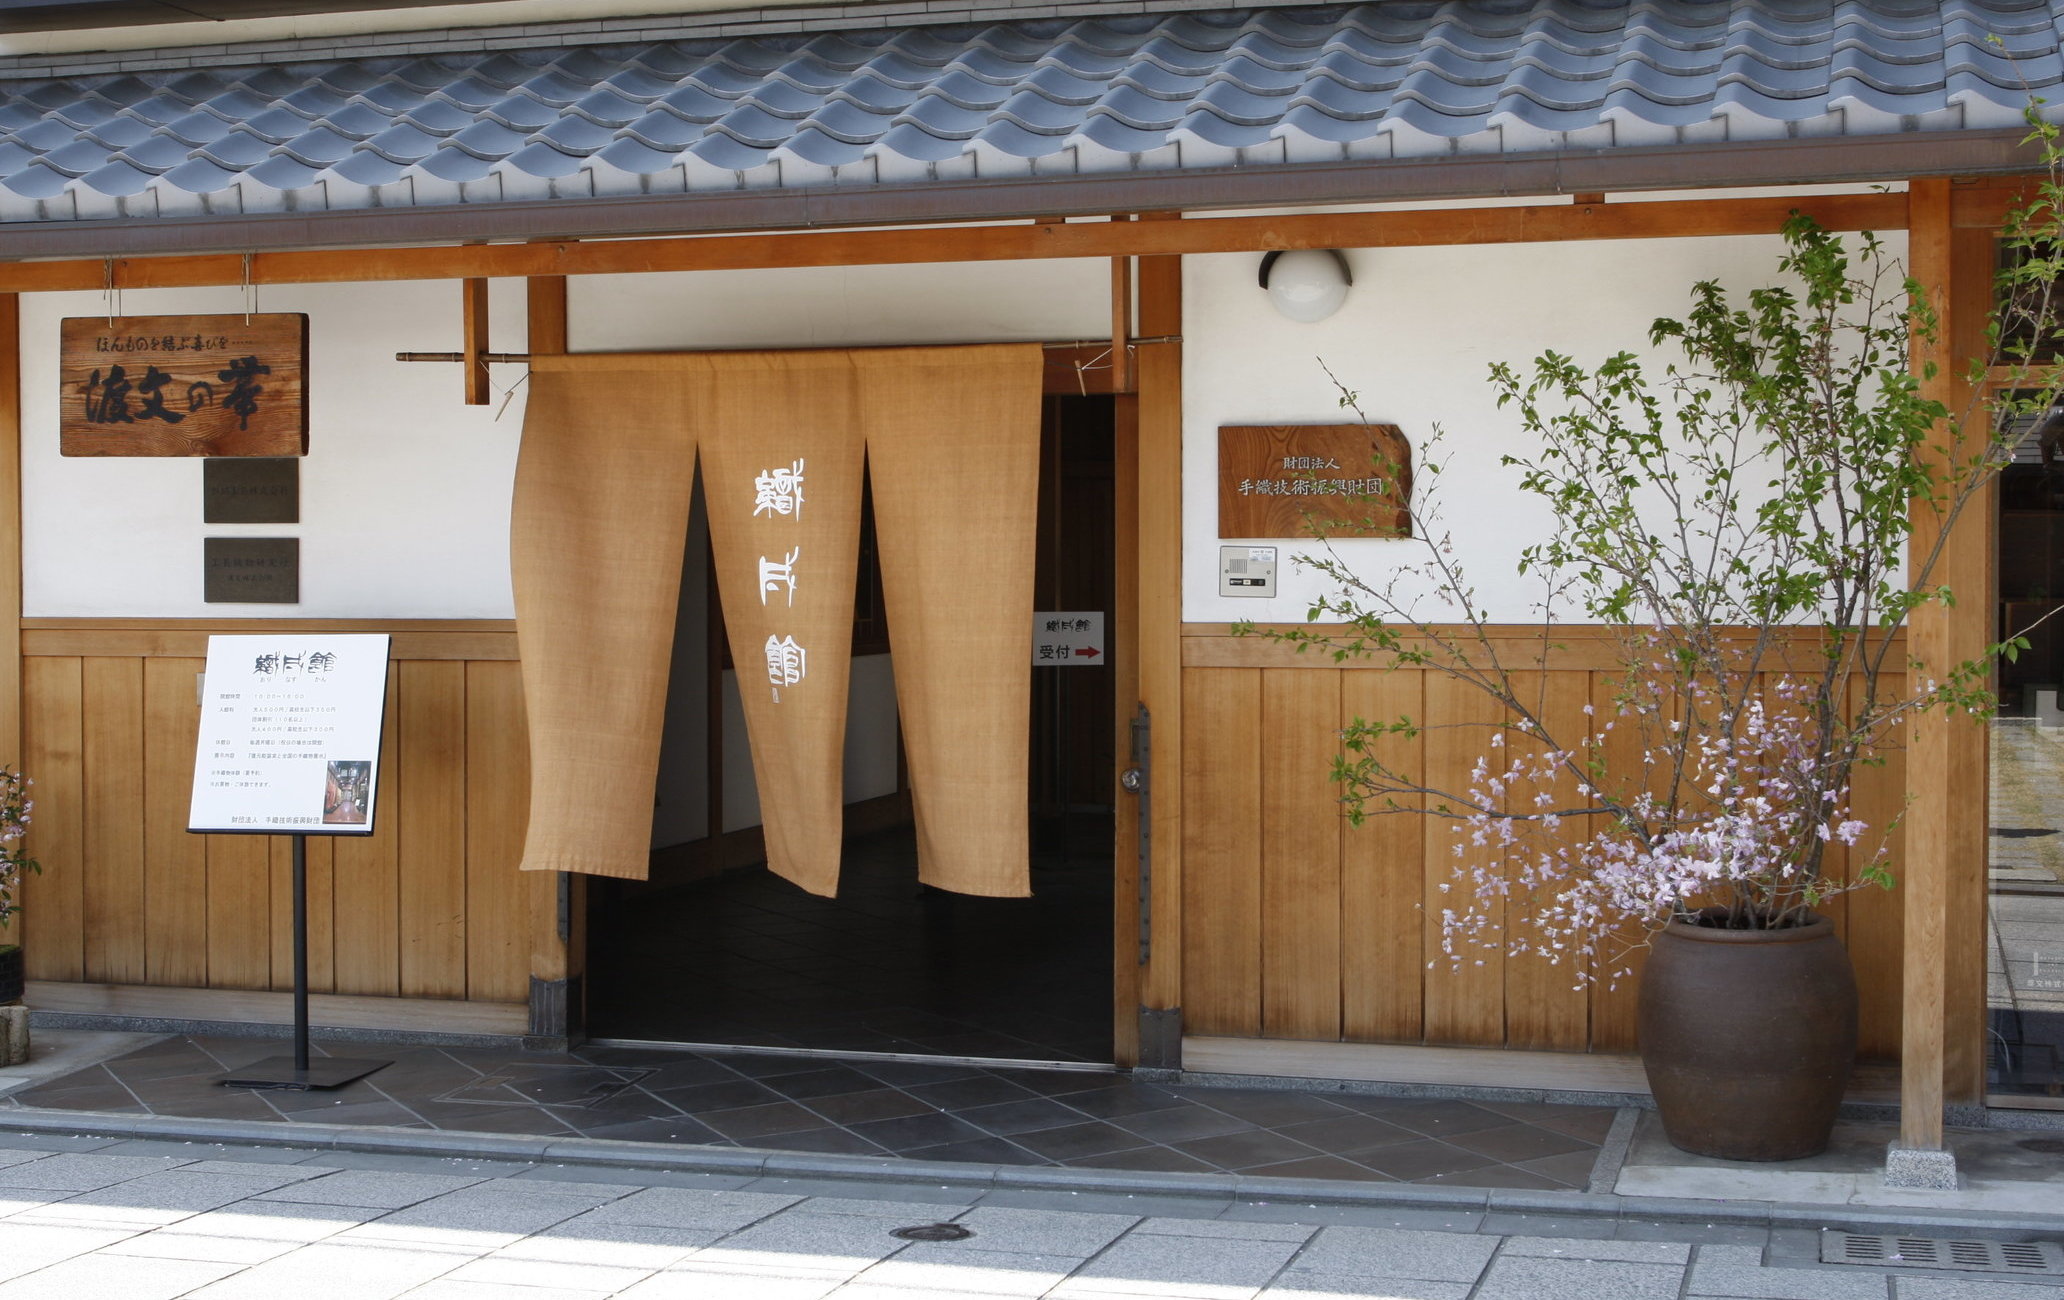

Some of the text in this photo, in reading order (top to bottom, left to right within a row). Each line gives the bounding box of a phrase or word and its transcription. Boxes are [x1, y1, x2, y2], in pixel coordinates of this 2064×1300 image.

[1283, 456, 1341, 470] 財団法人
[1238, 478, 1382, 497] 手織技術振興財団
[1039, 644, 1070, 660] 受付
